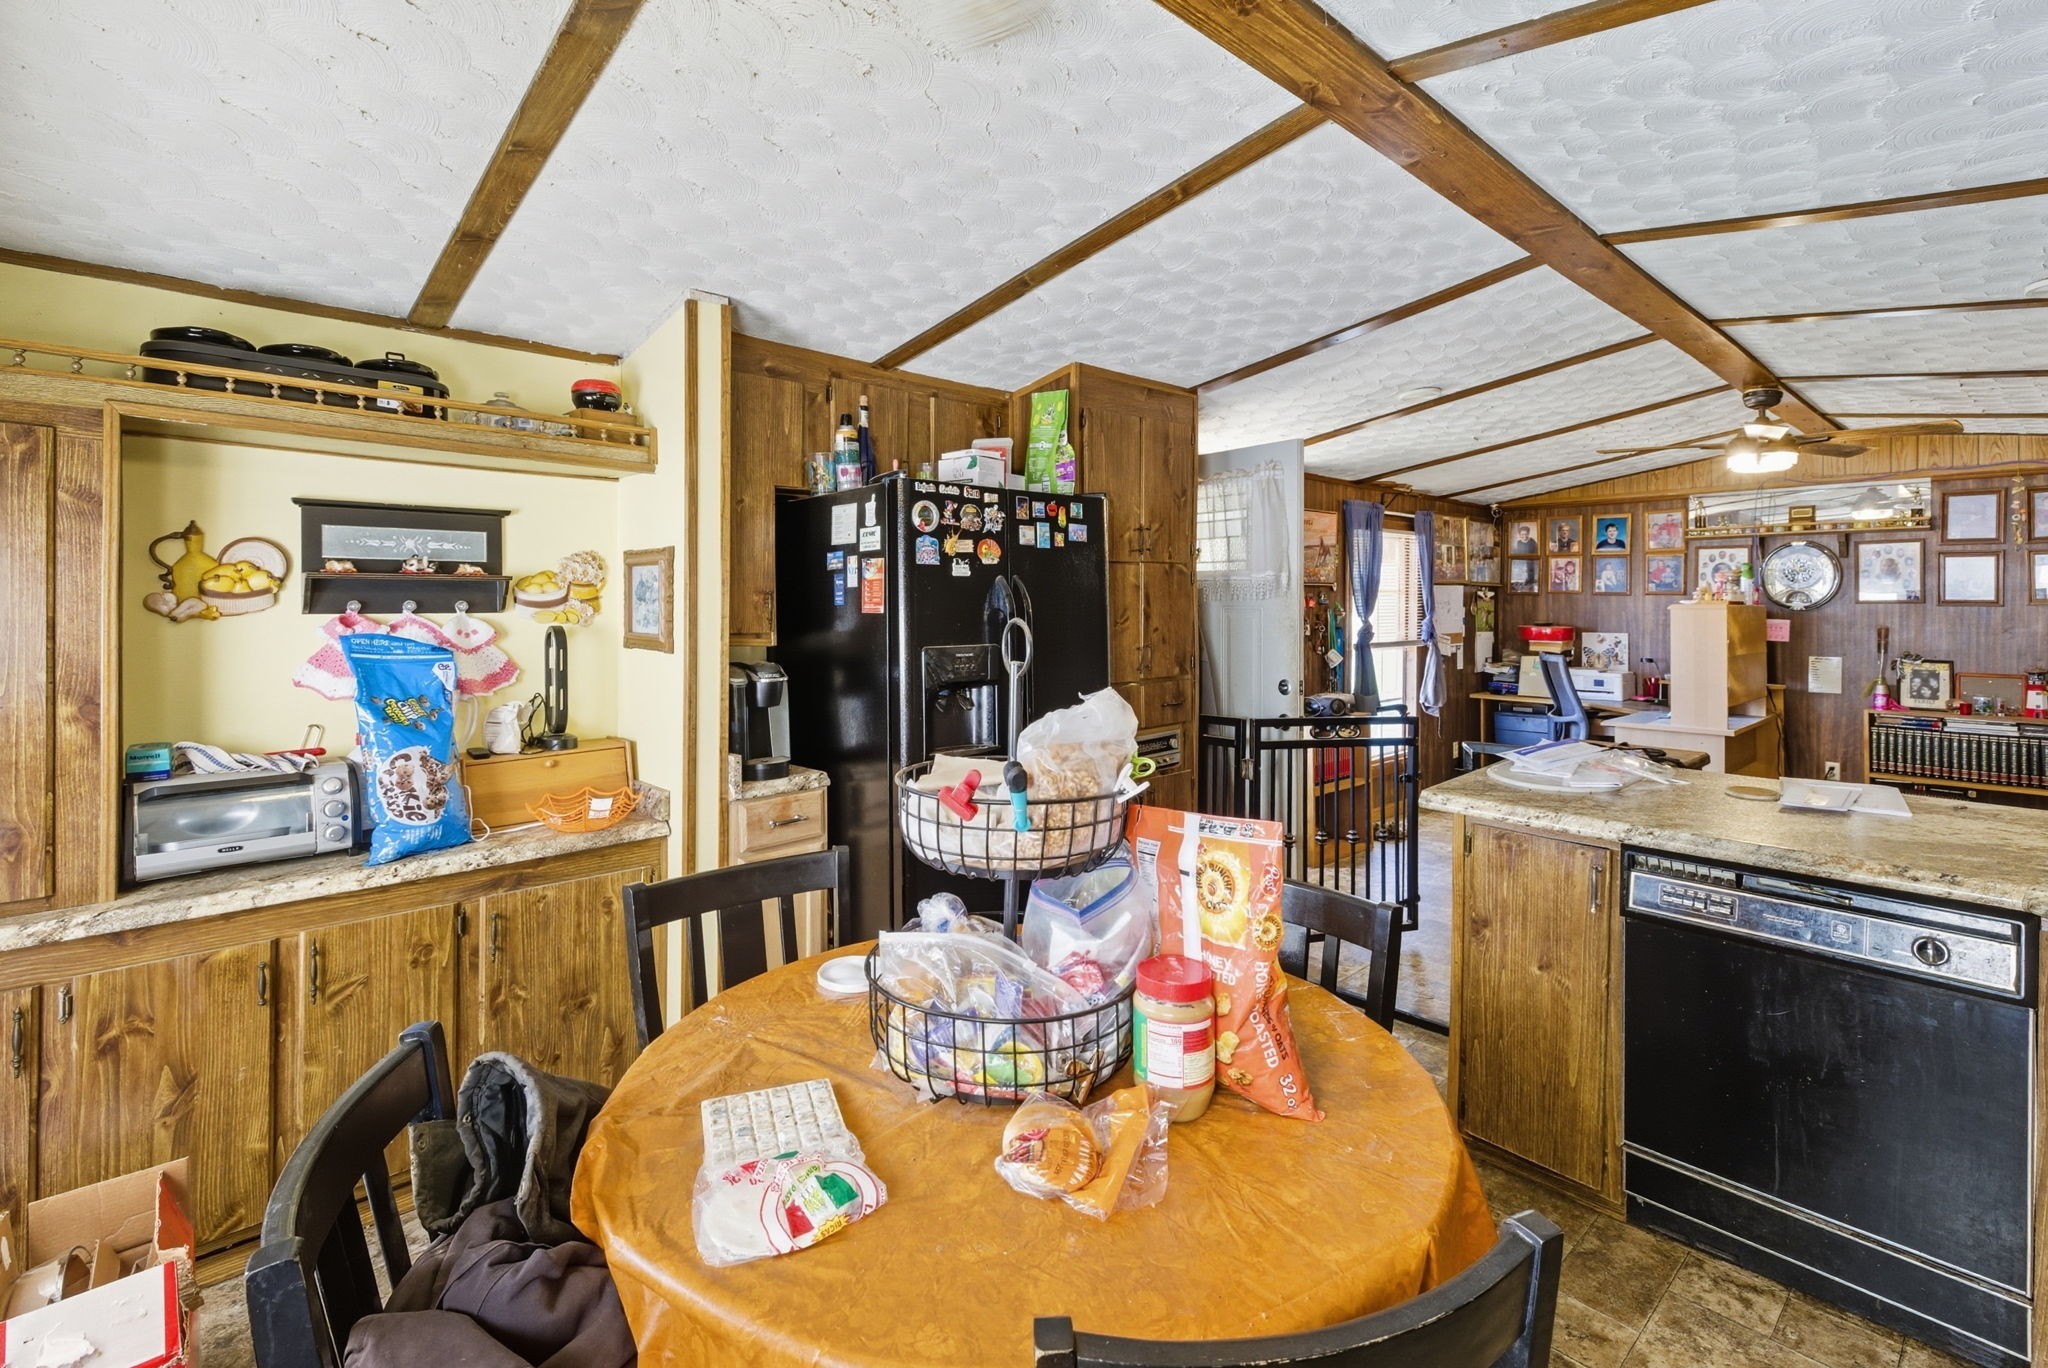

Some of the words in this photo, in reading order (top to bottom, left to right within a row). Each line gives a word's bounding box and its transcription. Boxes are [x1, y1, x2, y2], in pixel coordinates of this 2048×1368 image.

[1263, 863, 1279, 898] Post
[1275, 1033, 1289, 1060] OATS
[1279, 1073, 1297, 1097] 32
[820, 1219, 843, 1238] RICAS
